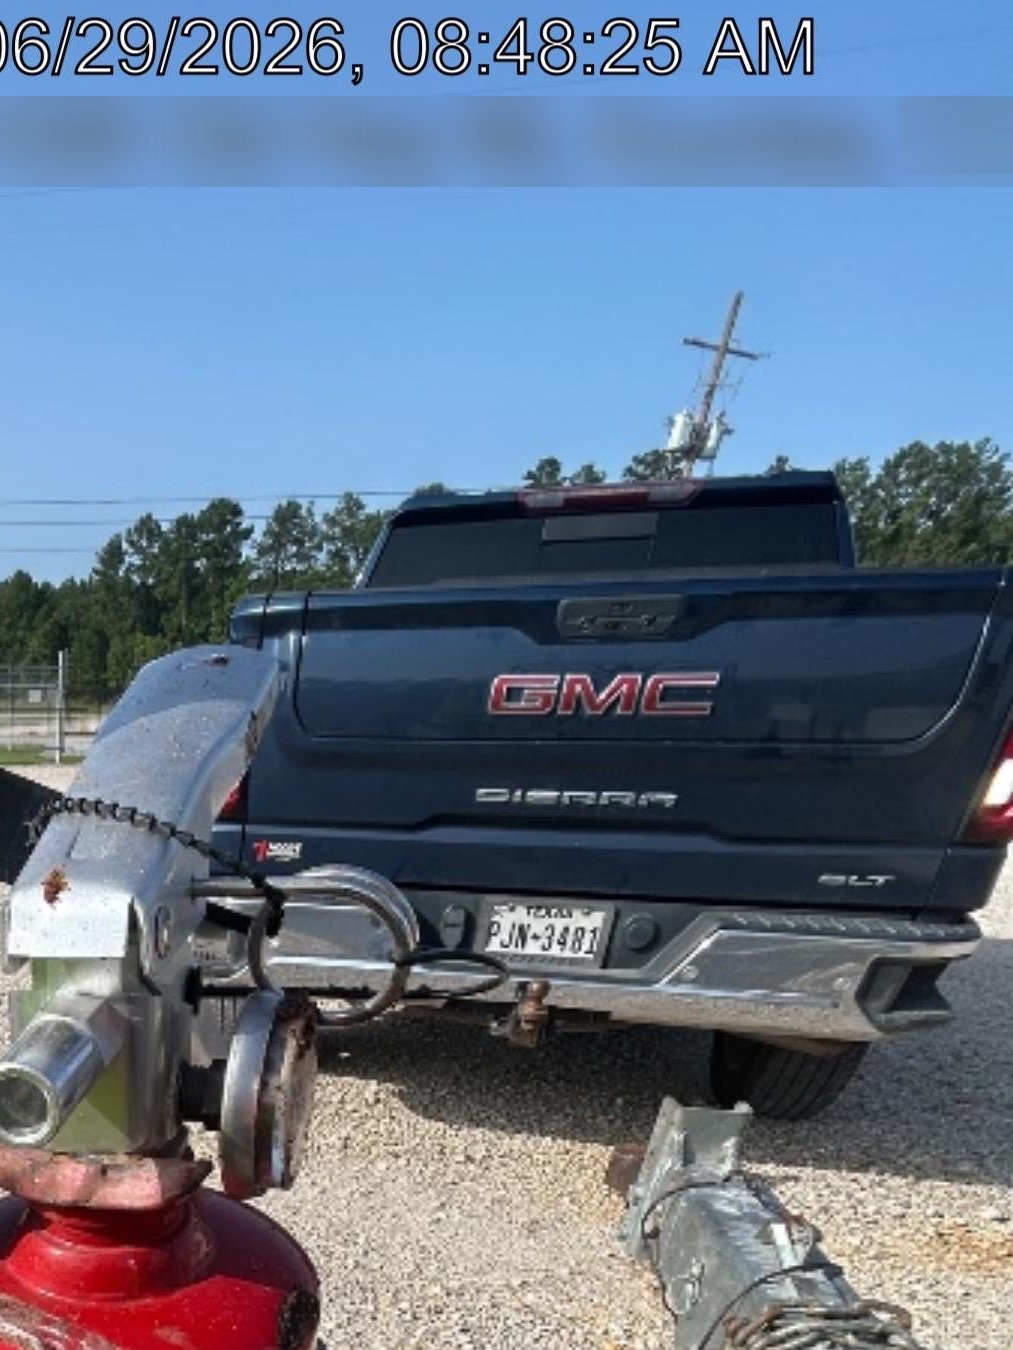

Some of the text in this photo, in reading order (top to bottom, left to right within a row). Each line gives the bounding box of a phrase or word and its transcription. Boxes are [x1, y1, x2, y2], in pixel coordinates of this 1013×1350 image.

[487, 671, 720, 715] GMC
[474, 787, 678, 808] SIERRA
[817, 873, 897, 887] SLT
